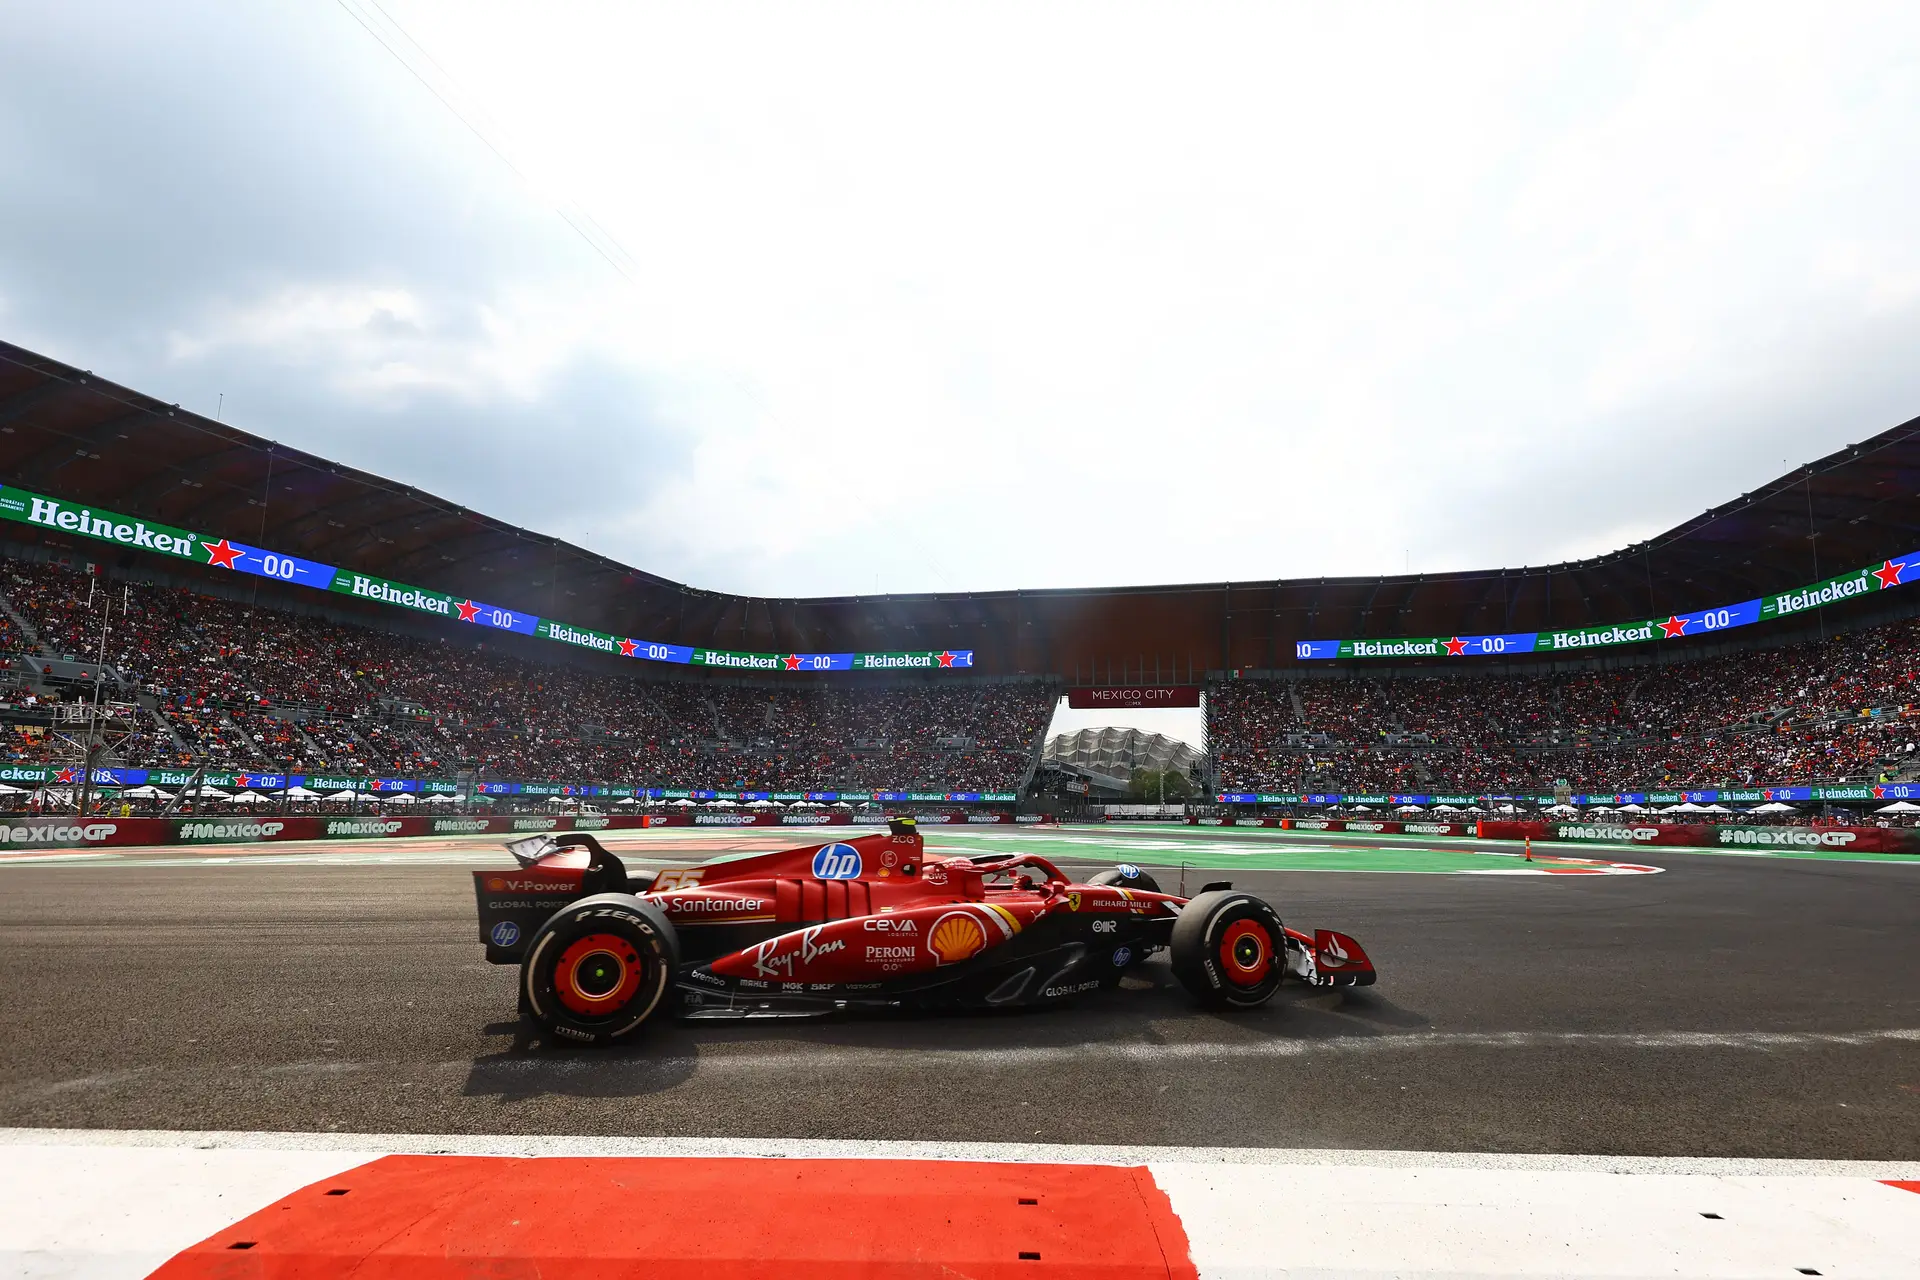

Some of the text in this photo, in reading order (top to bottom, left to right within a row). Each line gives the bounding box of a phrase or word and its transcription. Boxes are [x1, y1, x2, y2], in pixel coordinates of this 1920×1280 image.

[28, 497, 192, 557] Heineken
[352, 575, 449, 614] Heineken
[1777, 575, 1868, 615] Heineken
[548, 623, 613, 651] Heineken
[1553, 627, 1653, 649] Heineken
[1353, 641, 1437, 656] Heineken
[705, 652, 778, 669] Heineken
[864, 654, 931, 668] Heineken
[1092, 689, 1174, 700] MEXICO CITY
[435, 819, 489, 831] #MexicoGP
[514, 819, 556, 829] #MexicoGP
[575, 818, 609, 828] #MexicoGP
[695, 816, 756, 824] #MexicoGP
[782, 816, 830, 824] #MexicoGP
[1345, 822, 1384, 832] #MexicoGP
[180, 822, 284, 838] #MexicoGP
[327, 821, 402, 835] #MexicoGP
[1405, 824, 1450, 834] #MexicoGP
[1558, 826, 1659, 841] #MexicoGP
[892, 835, 915, 844] ZCG
[1719, 829, 1856, 846] #MexicoGP
[820, 845, 857, 879] hp
[507, 880, 576, 891] V-Power
[654, 869, 705, 891] 55
[489, 901, 533, 909] GLOBAL
[672, 897, 764, 913] Santander
[1092, 899, 1152, 909] RICHARD MILLE
[595, 909, 654, 935] ZERO
[495, 923, 515, 946] hp
[866, 946, 915, 958] PERONI
[691, 970, 726, 986] brembo
[782, 982, 804, 990] NGK
[1046, 984, 1077, 997] GLOBAL
